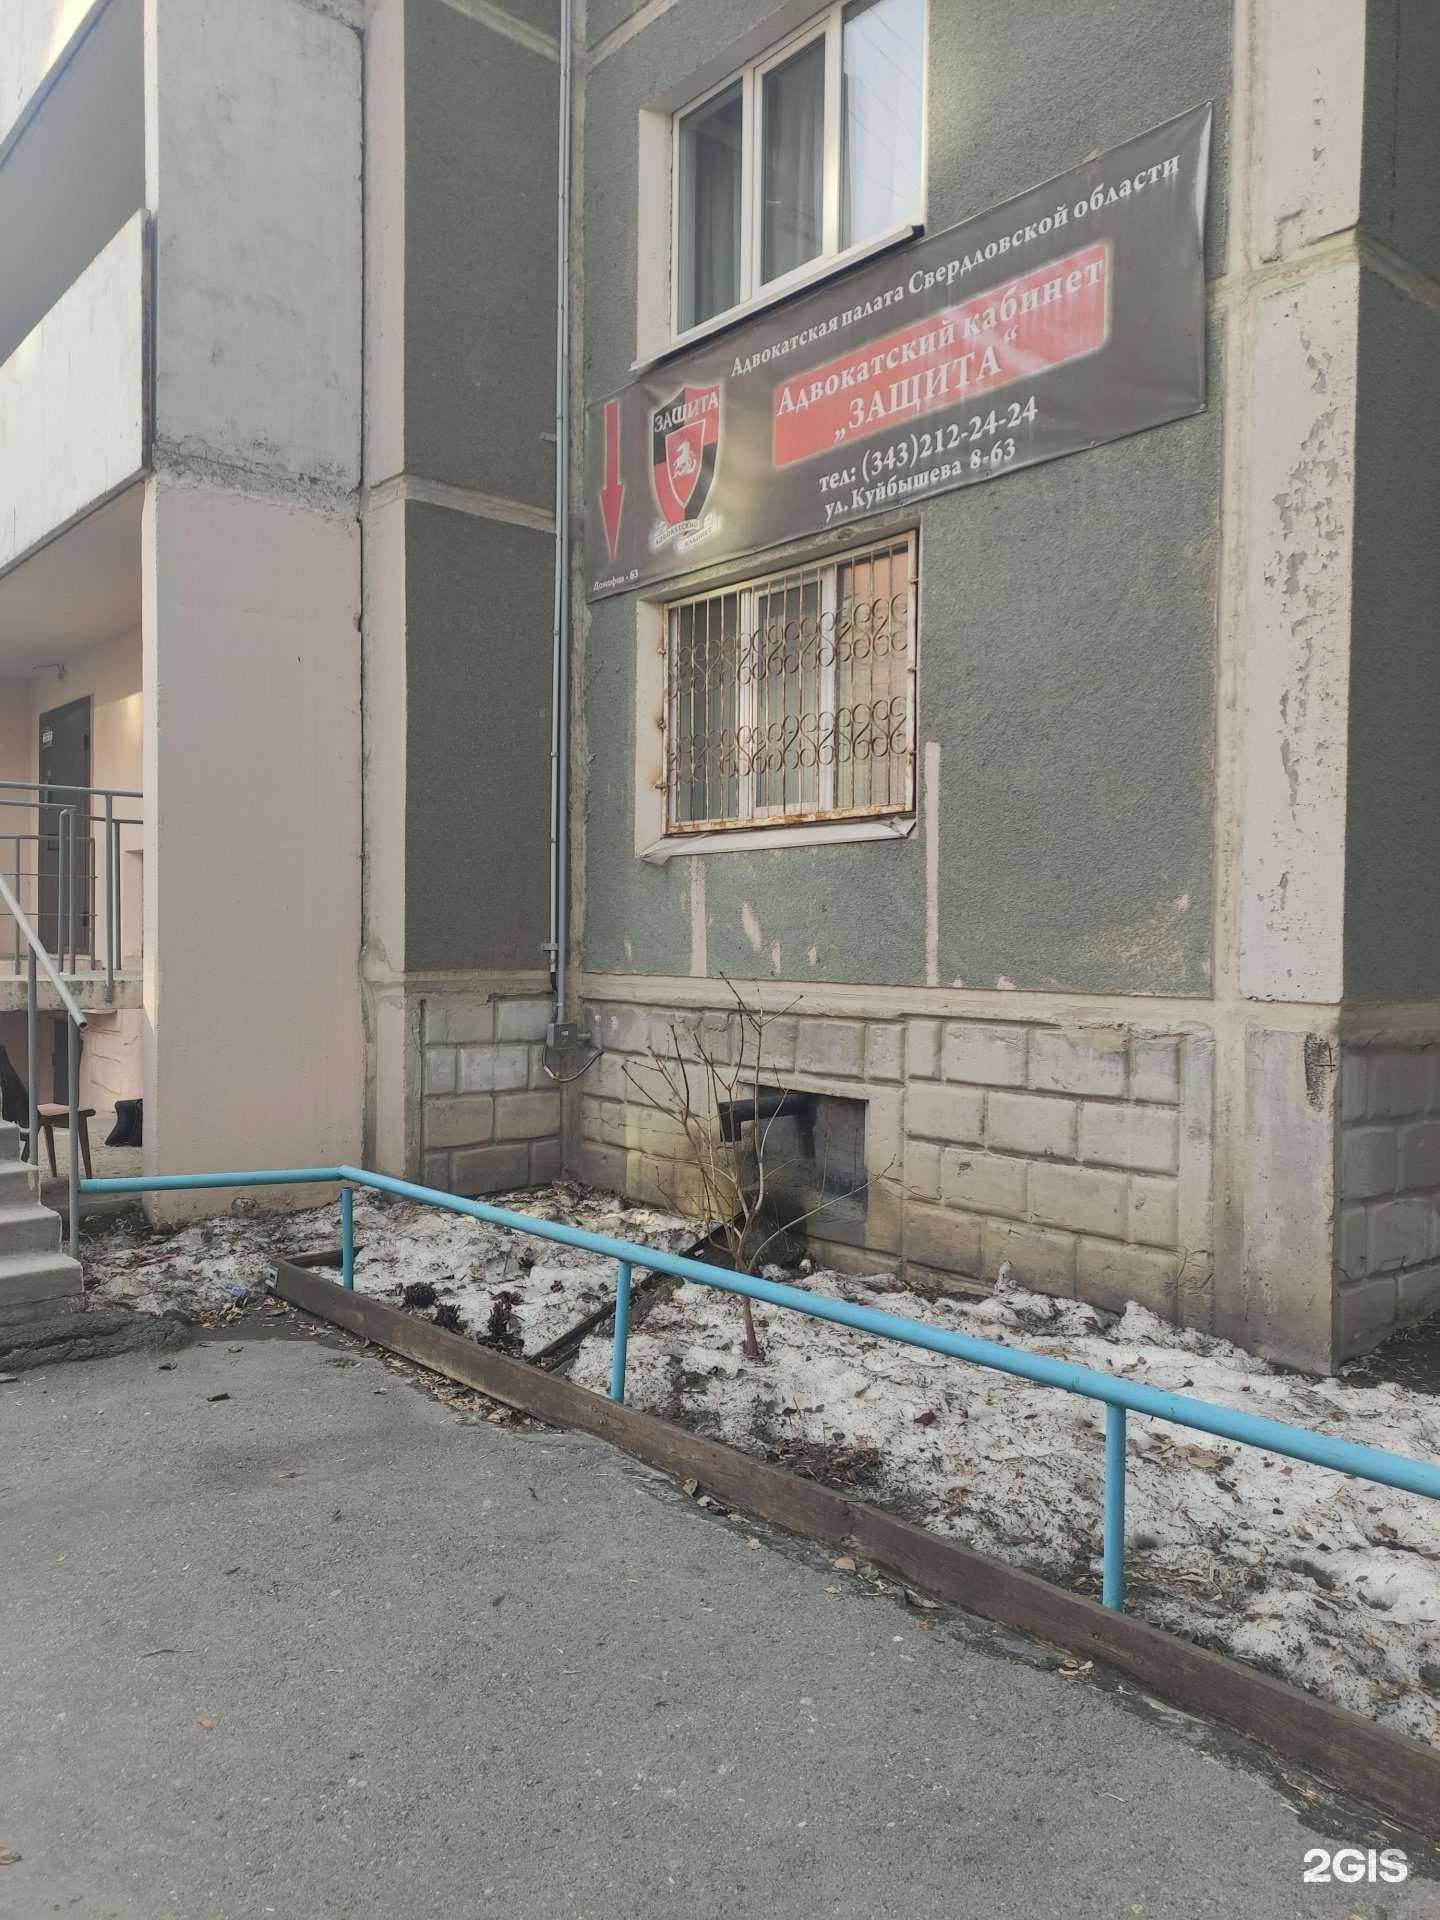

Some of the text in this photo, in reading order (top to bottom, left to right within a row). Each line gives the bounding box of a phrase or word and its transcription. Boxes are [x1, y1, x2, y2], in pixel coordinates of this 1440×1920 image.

[731, 155, 1181, 377] Адвокатская палата Свердловской области
[776, 260, 1104, 417] Адвокатский кабинет
[654, 391, 719, 432] ЗАЩИТА
[818, 396, 1038, 493] тел: (343)212-24-24
[824, 438, 1016, 523] ул. Куйбышева 8-63
